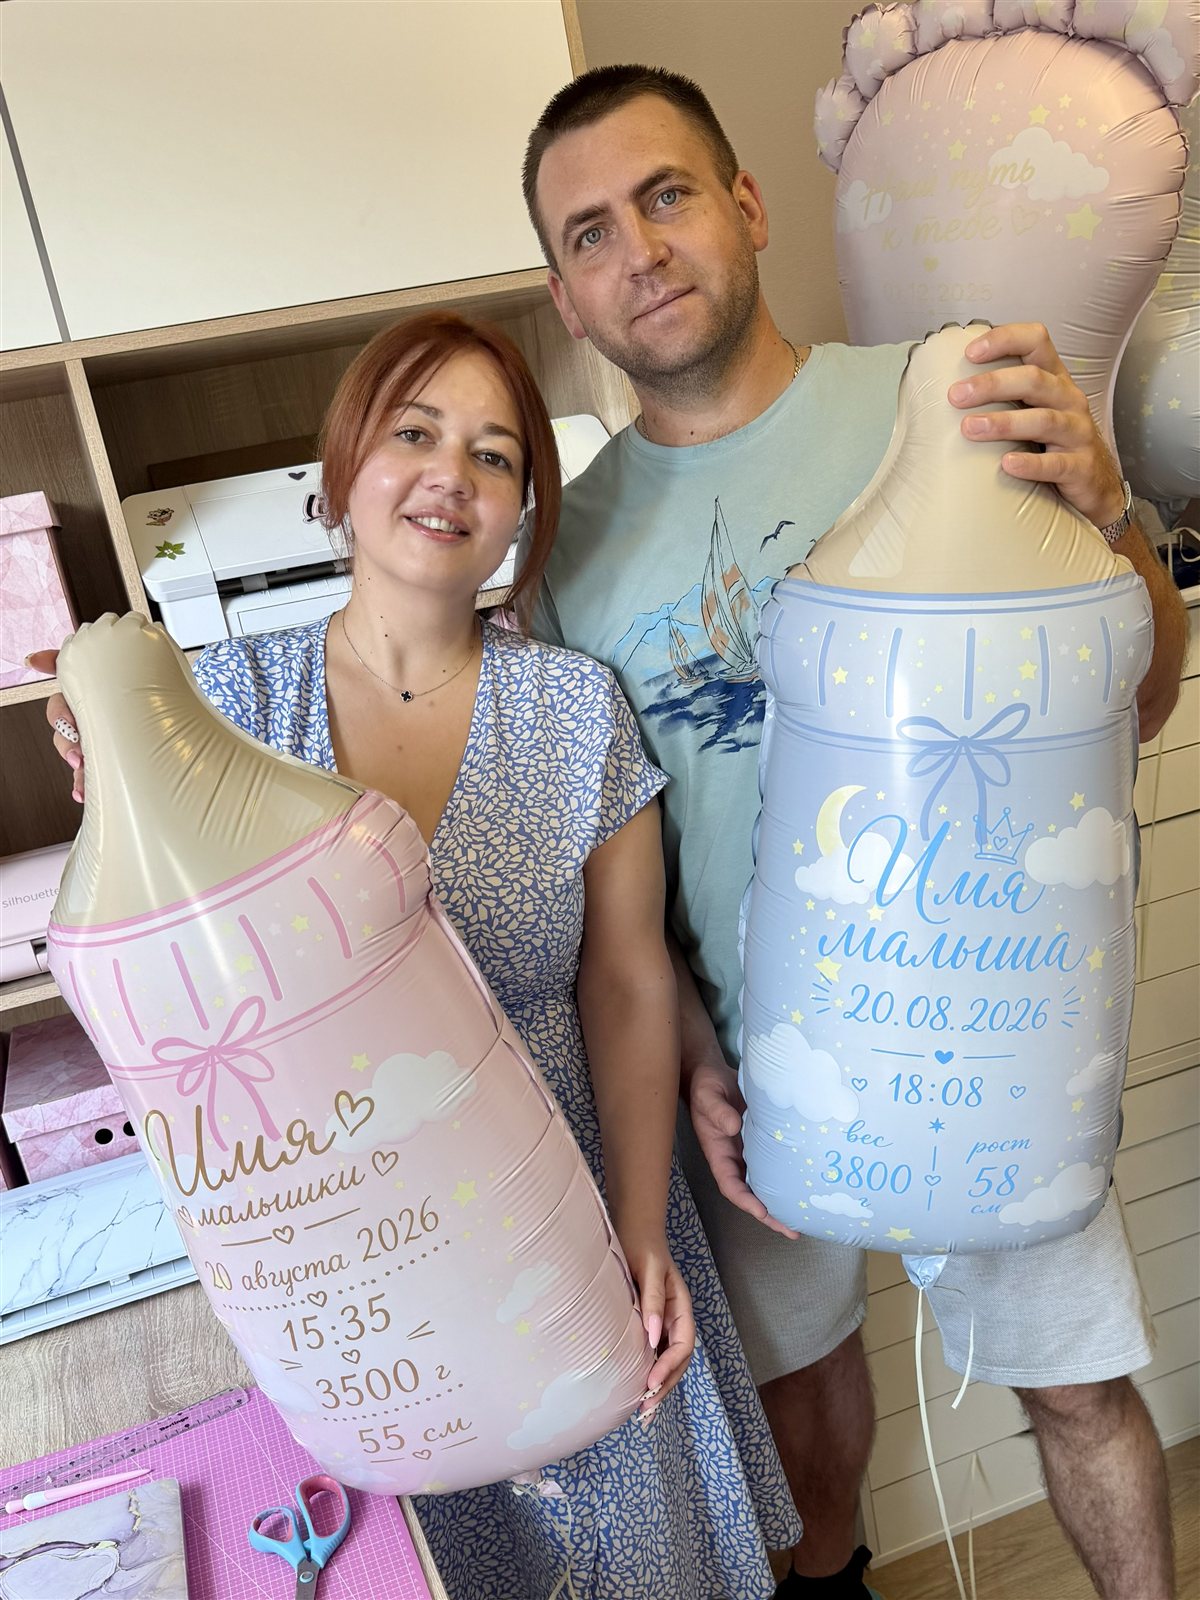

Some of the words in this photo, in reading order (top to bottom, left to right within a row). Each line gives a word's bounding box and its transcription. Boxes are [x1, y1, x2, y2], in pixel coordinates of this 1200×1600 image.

[847, 814, 1046, 924] Имя
[819, 923, 1086, 973] малыша
[843, 984, 1050, 1033] 20.08.2026
[888, 1073, 984, 1108] 18:08
[144, 1104, 337, 1197] Имя
[842, 1120, 894, 1148] вес
[966, 1136, 1033, 1164] рост
[198, 1165, 367, 1227] малышки
[820, 1150, 912, 1195] 3800
[968, 1163, 1020, 1198] 58
[858, 1196, 872, 1208] г
[970, 1203, 1001, 1214] см
[205, 1261, 233, 1291] 20
[241, 1254, 351, 1297] августа
[357, 1195, 440, 1262] 2026
[282, 1293, 391, 1351] 15:35
[315, 1358, 420, 1410] 3500
[435, 1364, 451, 1380] г
[358, 1423, 405, 1454] 55
[423, 1417, 473, 1442] см
